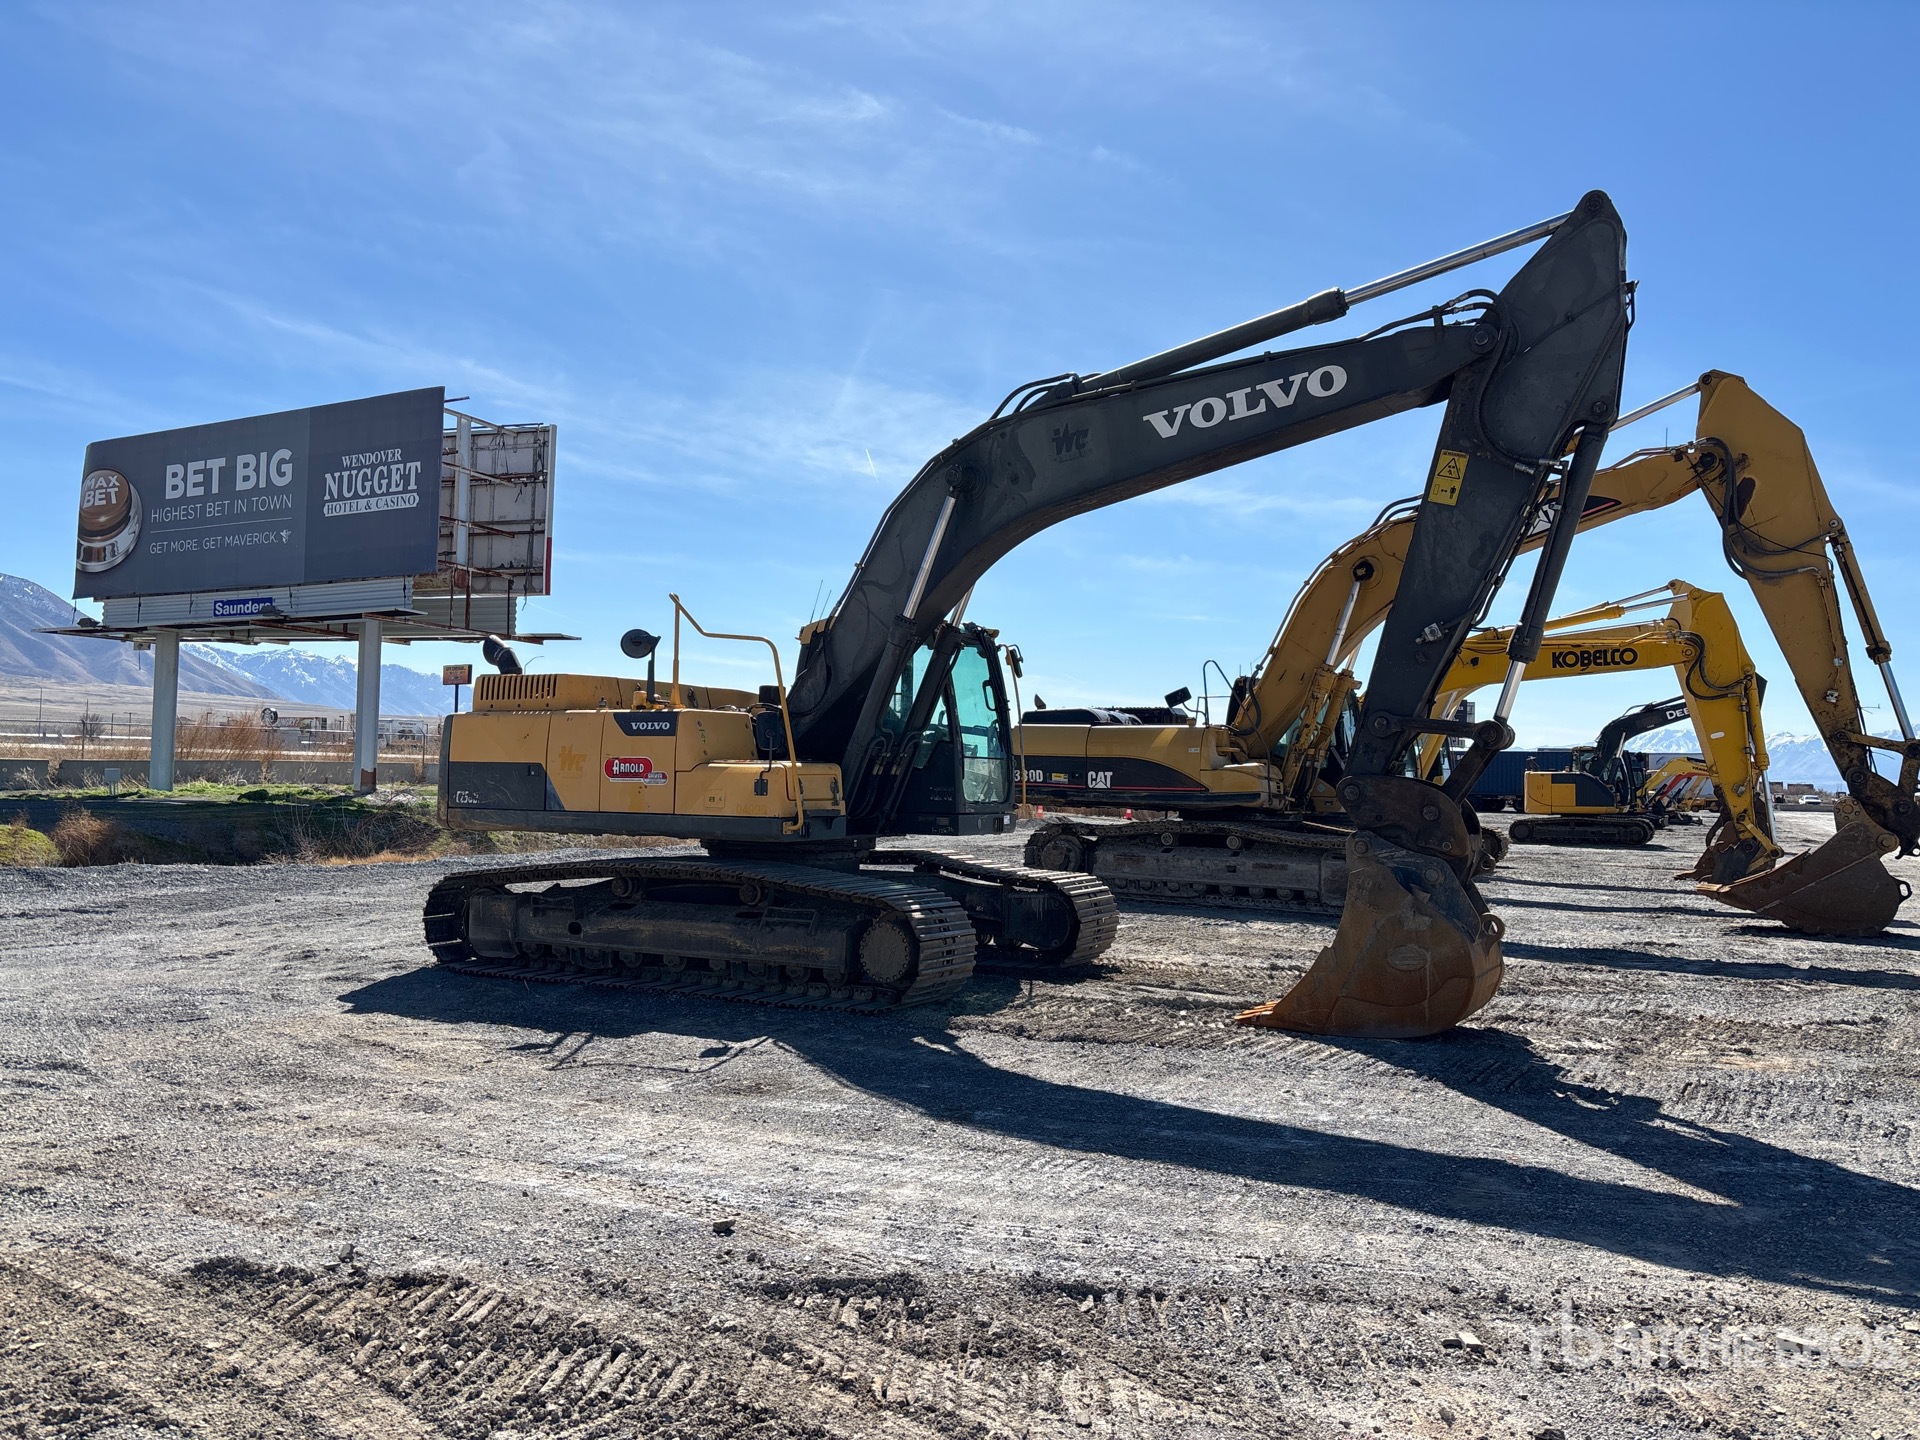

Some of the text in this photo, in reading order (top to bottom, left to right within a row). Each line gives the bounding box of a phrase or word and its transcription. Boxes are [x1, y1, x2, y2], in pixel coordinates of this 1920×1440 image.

[1143, 365, 1347, 438] VOLVO
[341, 448, 402, 468] WENDOVER
[85, 475, 120, 490] MAX
[165, 448, 293, 500] BET BIG
[323, 461, 421, 500] NUGGET
[82, 487, 119, 509] BET
[151, 493, 292, 523] HIGHEST BET IN TOWN
[326, 494, 416, 514] HOTEL & CASINO
[149, 541, 168, 554] GET
[202, 536, 222, 549] GET
[224, 531, 279, 547] MAVERICK.
[1551, 647, 1638, 671] KOBELCO
[1666, 707, 1690, 720] DEE
[631, 722, 670, 730] VOLVO
[1087, 771, 1113, 789] CAT
